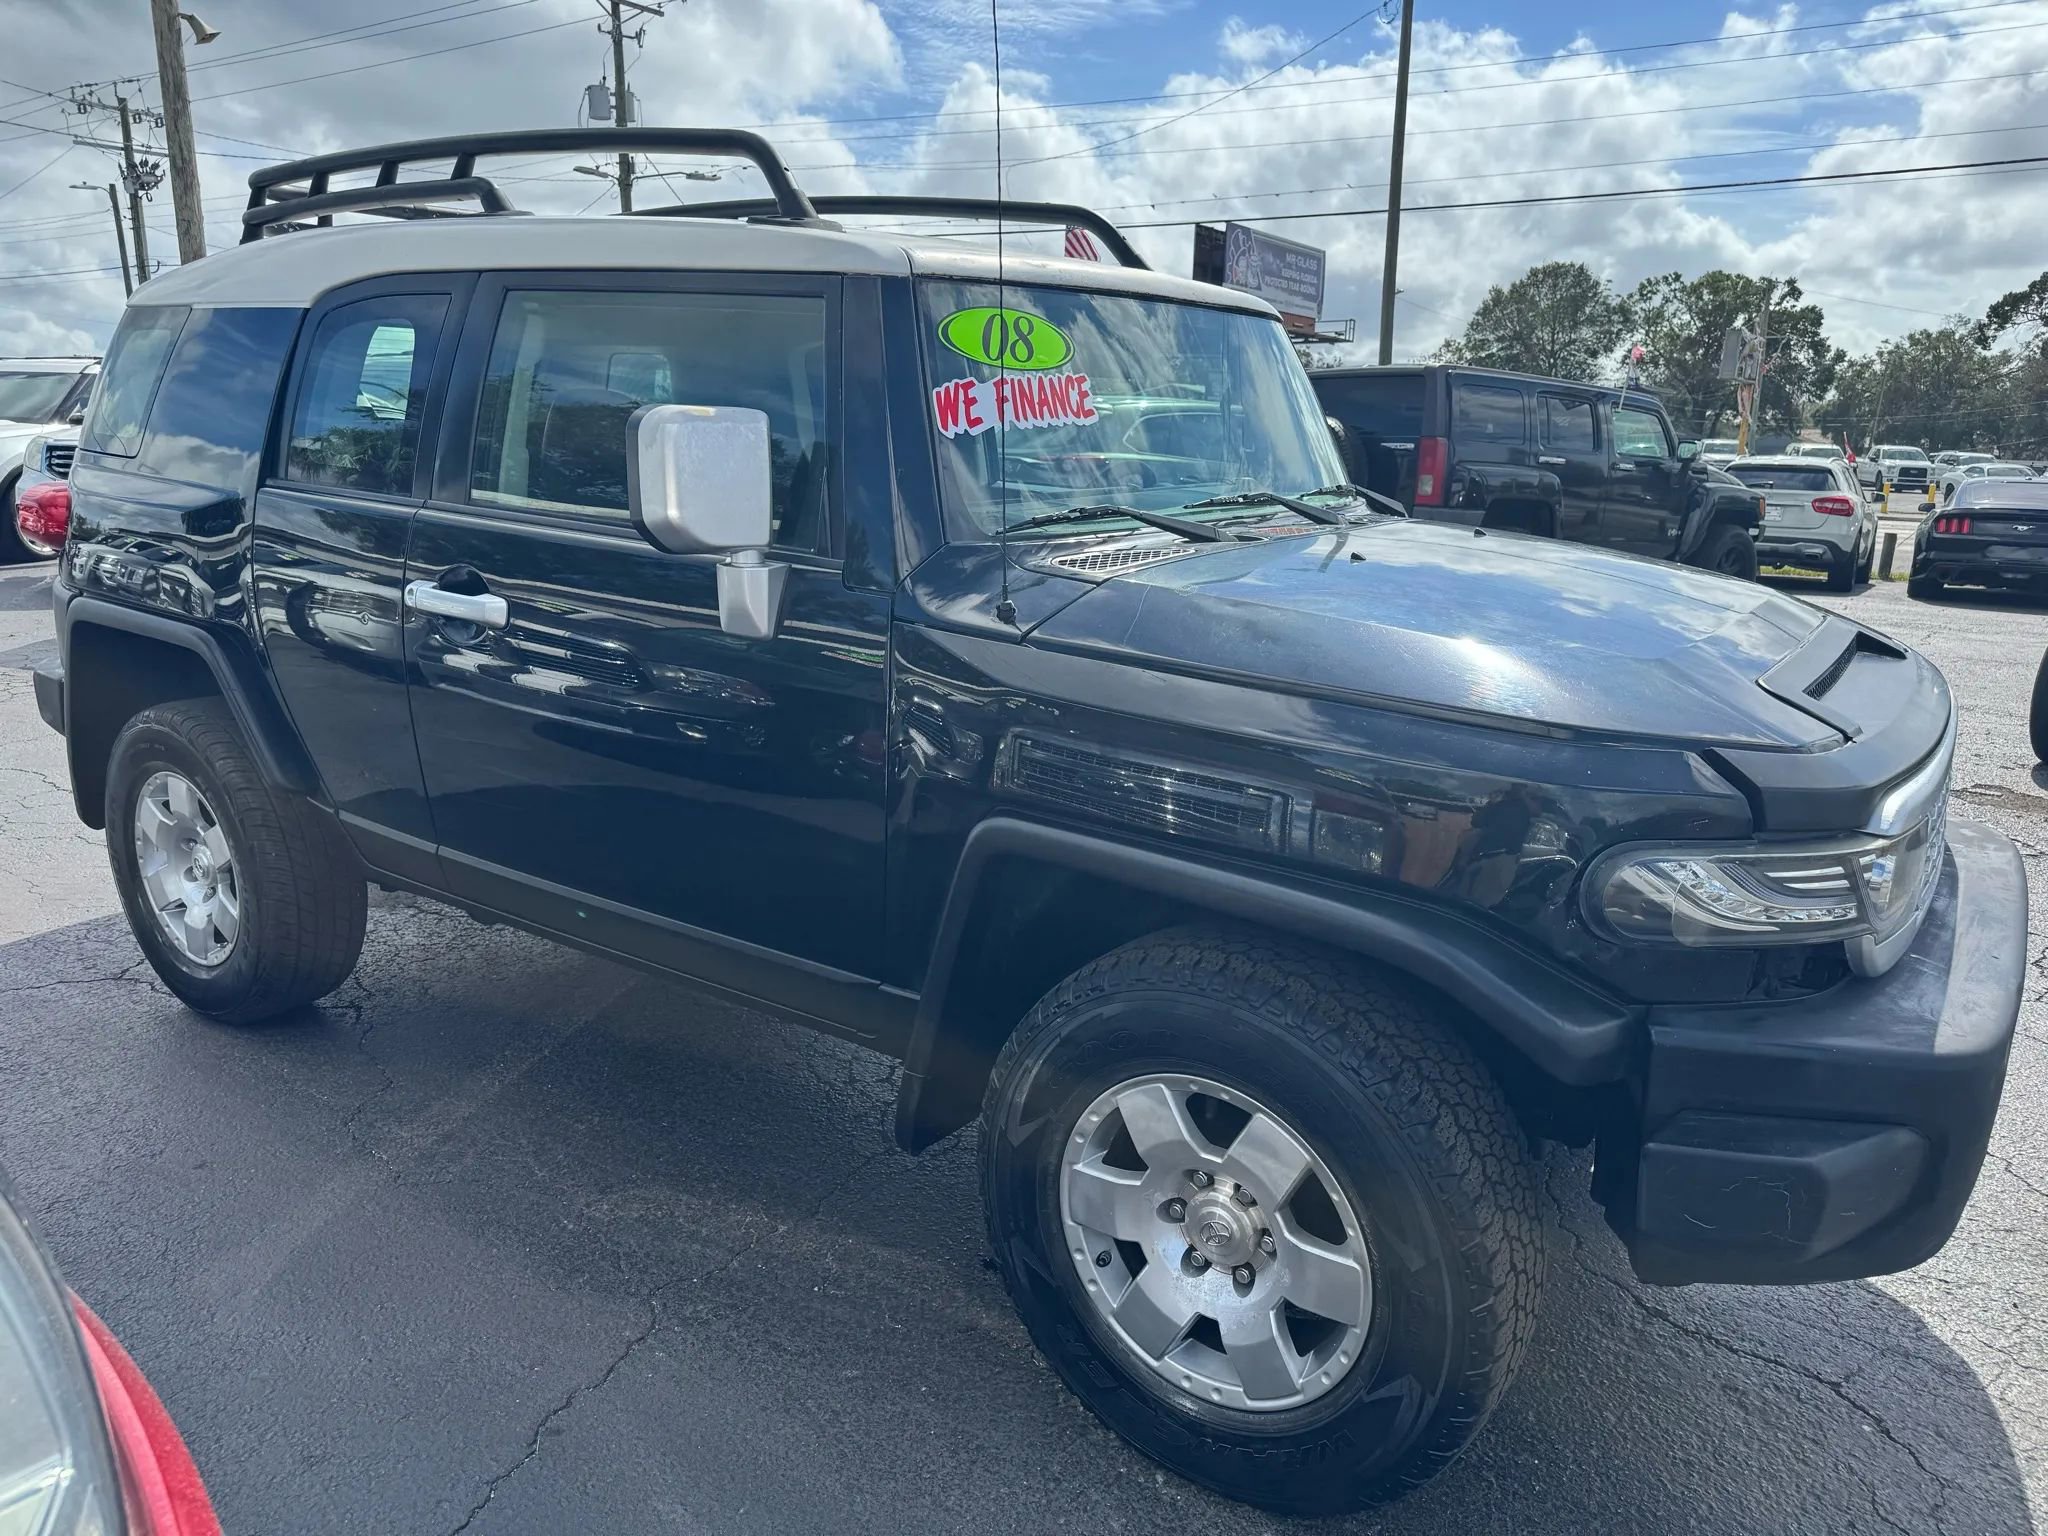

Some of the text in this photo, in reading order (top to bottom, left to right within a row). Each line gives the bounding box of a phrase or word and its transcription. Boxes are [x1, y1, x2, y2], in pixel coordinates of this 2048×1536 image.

[981, 313, 1035, 363] 08
[935, 374, 1096, 433] WE FINANCE
